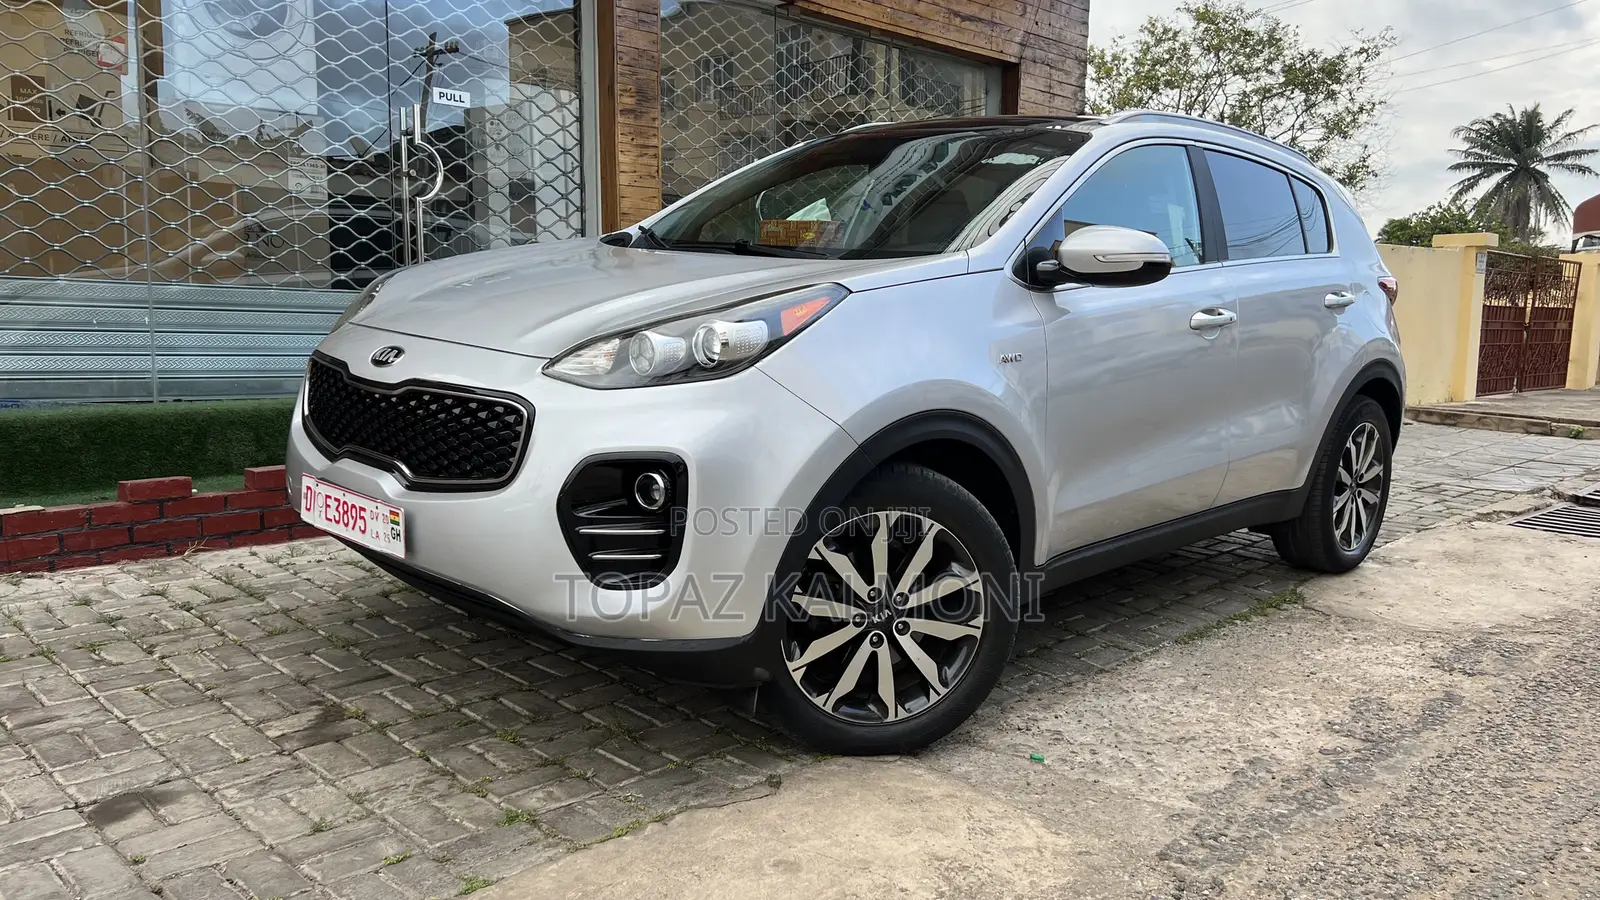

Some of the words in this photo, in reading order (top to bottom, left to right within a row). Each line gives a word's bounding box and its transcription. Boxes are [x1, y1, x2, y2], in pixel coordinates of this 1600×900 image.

[438, 91, 466, 104] PULL
[999, 353, 1022, 364] AWD
[325, 493, 367, 535] E3895
[371, 528, 380, 540] LA
[391, 526, 401, 543] GH
[872, 609, 892, 623] KIA
